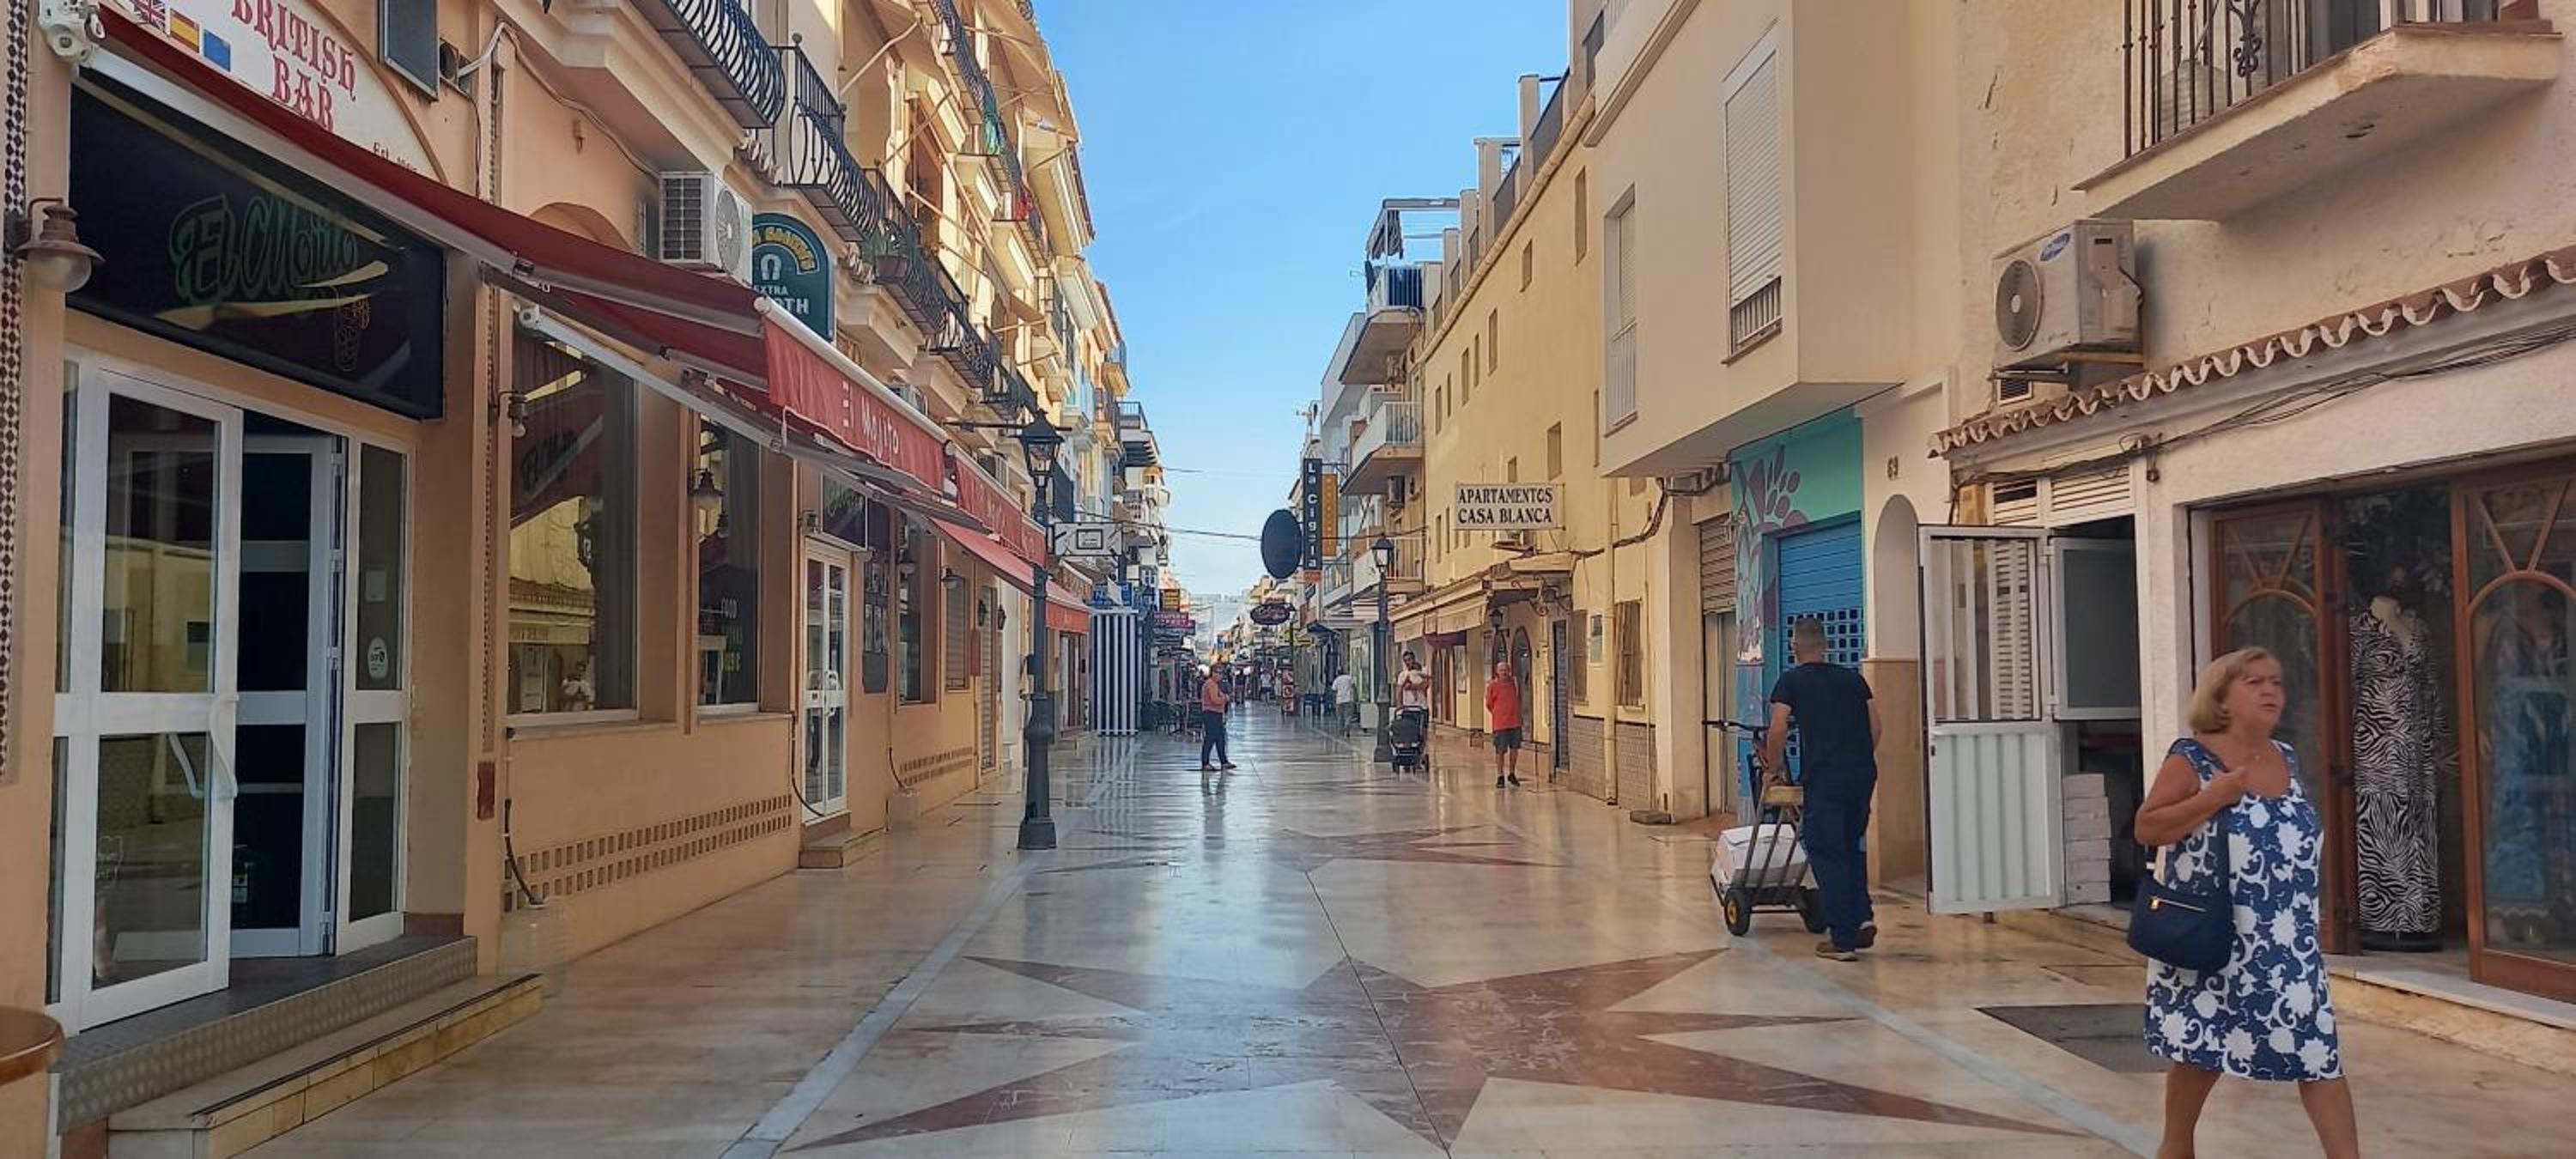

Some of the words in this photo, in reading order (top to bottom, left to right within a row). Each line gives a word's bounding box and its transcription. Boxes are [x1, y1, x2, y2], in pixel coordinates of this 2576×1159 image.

[272, 53, 335, 132] BAR
[1458, 487, 1553, 504] APARTAMENTOS
[1457, 507, 1495, 525] CASA
[1499, 507, 1552, 524] BLANCA
